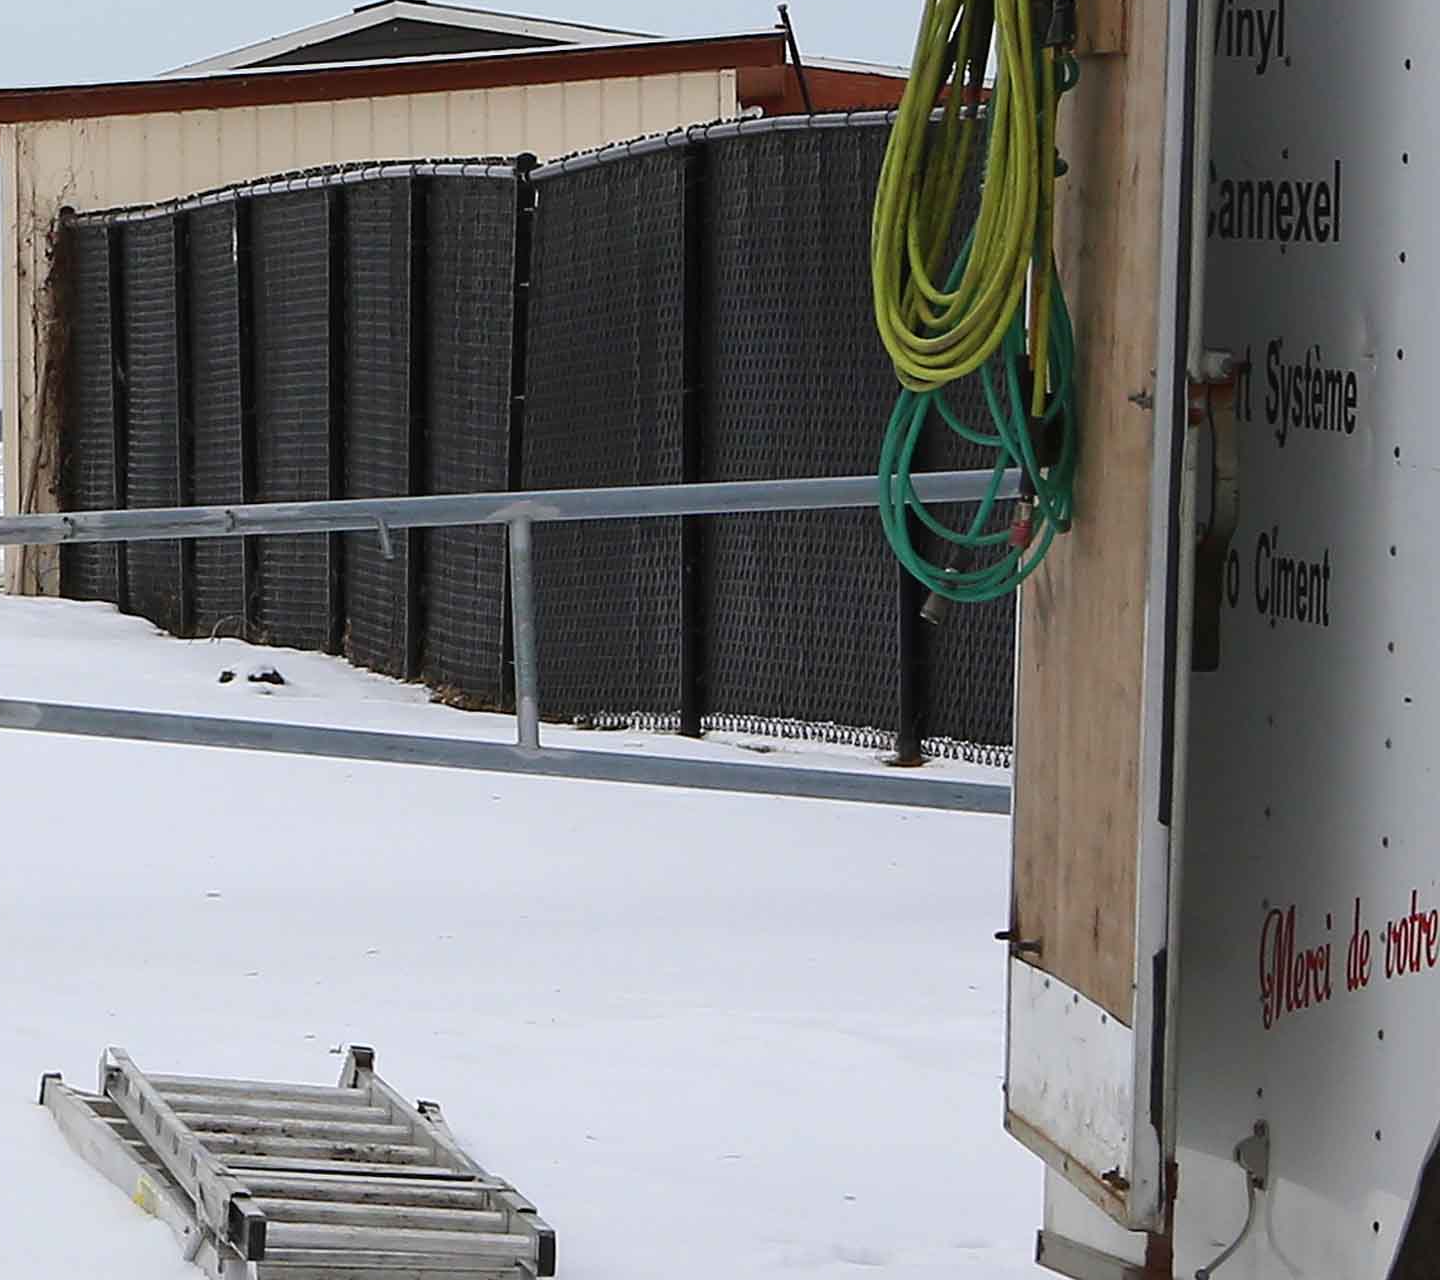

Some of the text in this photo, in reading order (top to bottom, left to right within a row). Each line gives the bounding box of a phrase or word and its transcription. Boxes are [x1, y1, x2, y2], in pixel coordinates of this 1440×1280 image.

[1265, 340, 1357, 448] Système
[1255, 526, 1331, 627] Ciment
[1259, 889, 1440, 1030] Merci de votre
